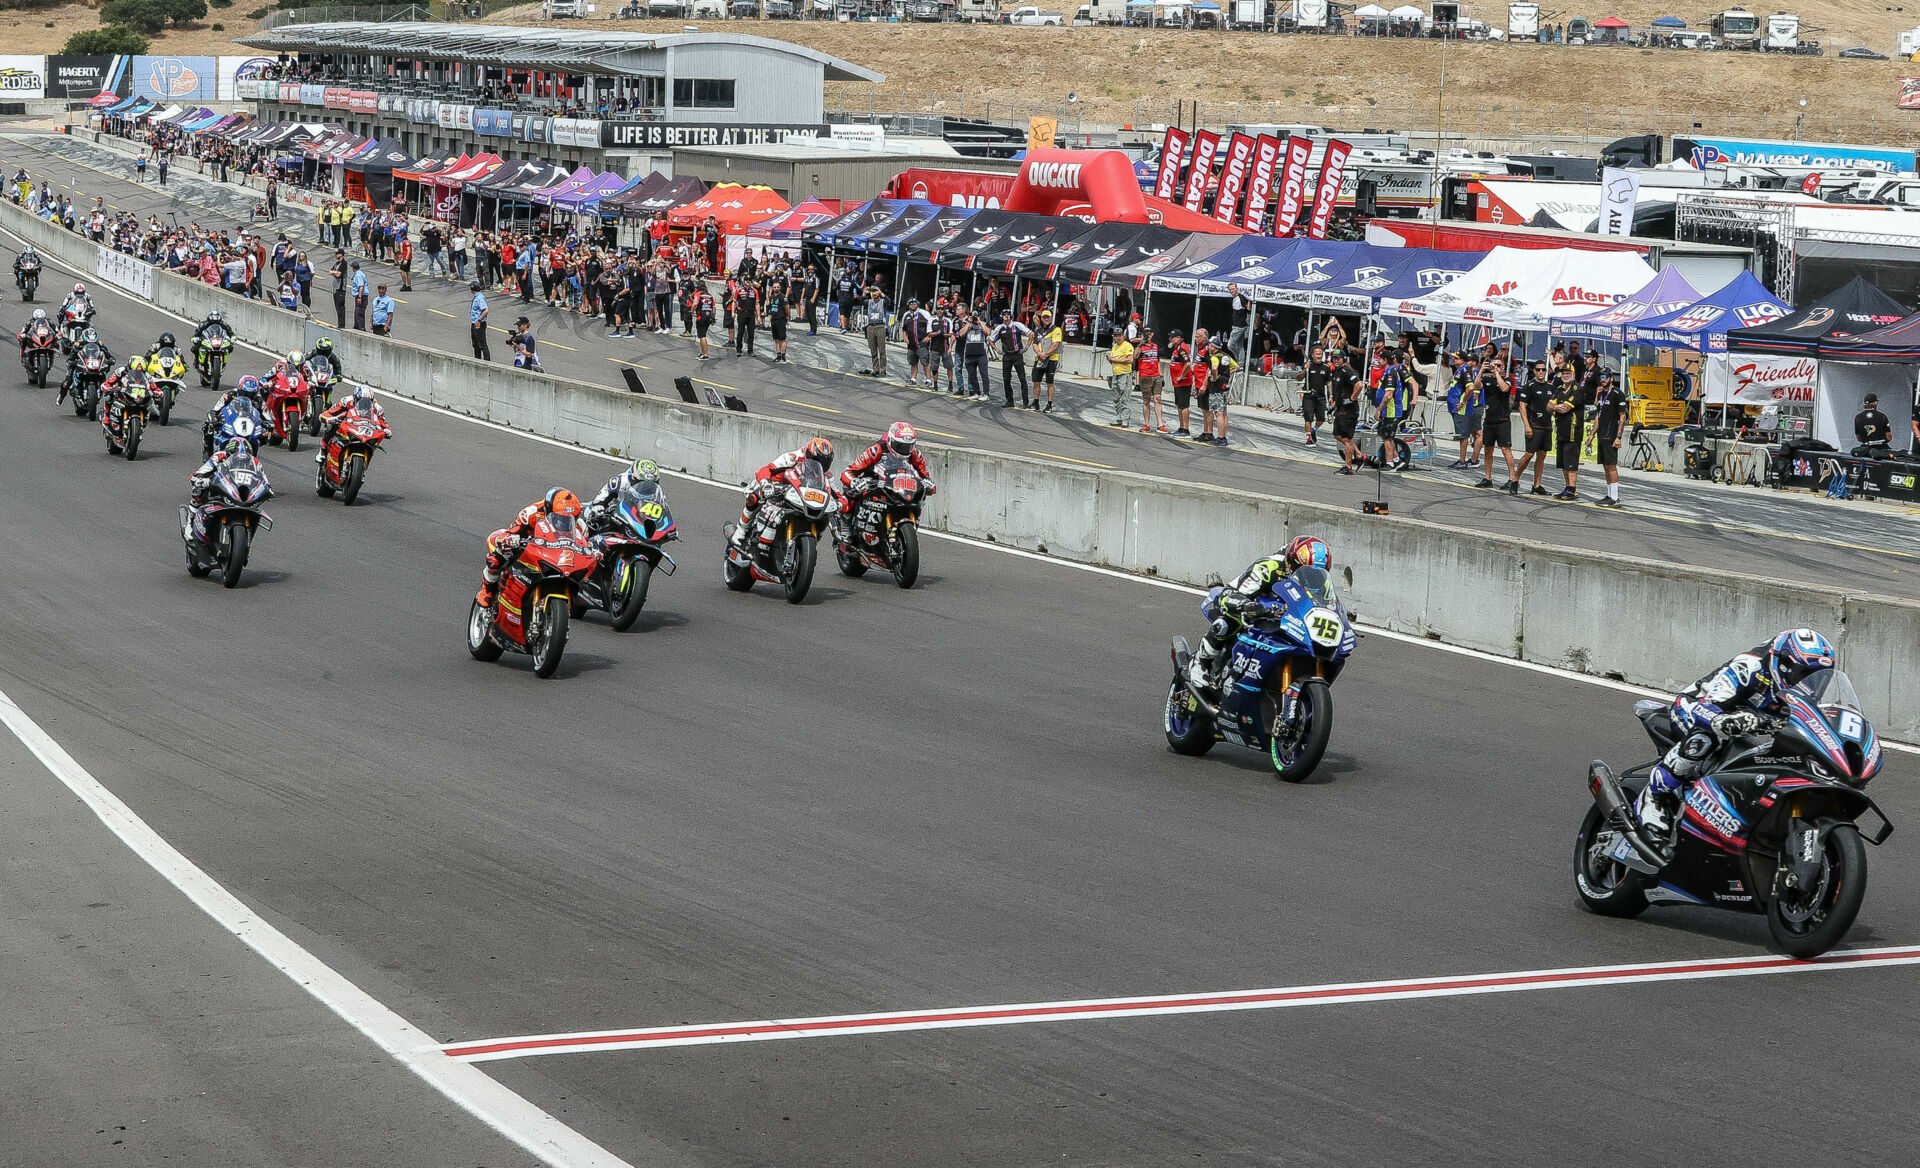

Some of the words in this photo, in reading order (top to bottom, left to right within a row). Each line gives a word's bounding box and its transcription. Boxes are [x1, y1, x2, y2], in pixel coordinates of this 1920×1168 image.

[59, 67, 99, 77] HAGERTY
[59, 78, 93, 86] Motorsports
[614, 126, 643, 144] LIFE
[648, 127, 662, 143] IS
[665, 127, 718, 145] BETTER
[722, 128, 740, 145] AT
[744, 128, 769, 145] THE
[1029, 162, 1082, 189] DUCATI
[1159, 135, 1183, 200] DUCA
[1185, 138, 1214, 212] DUCAT
[1247, 142, 1276, 233] DUCATI
[1279, 144, 1308, 234] DUCATI
[1377, 174, 1422, 189] Indian
[1312, 148, 1345, 238] DUCATI
[1314, 292, 1331, 305] TYTLERS
[1332, 296, 1349, 307] CYCLE
[1350, 297, 1370, 310] RACING
[1398, 301, 1427, 312] Aftercare
[1464, 306, 1494, 319] Aftercare
[1577, 323, 1586, 333] OILS
[163, 358, 173, 366] 94
[1733, 358, 1815, 396] Friendly
[1788, 387, 1814, 401] YAM
[241, 420, 247, 433] 1
[358, 426, 374, 437] 76
[234, 470, 253, 486] 195
[893, 478, 917, 493] 98
[639, 502, 663, 519] 40
[557, 550, 574, 567] 2
[1311, 616, 1339, 640] 45
[1841, 711, 1862, 739] 6
[1693, 786, 1742, 833] TYTLERS
[1687, 799, 1706, 817] CYCLE
[1705, 814, 1733, 838] RACING
[1803, 829, 1813, 862] DUNLOP
